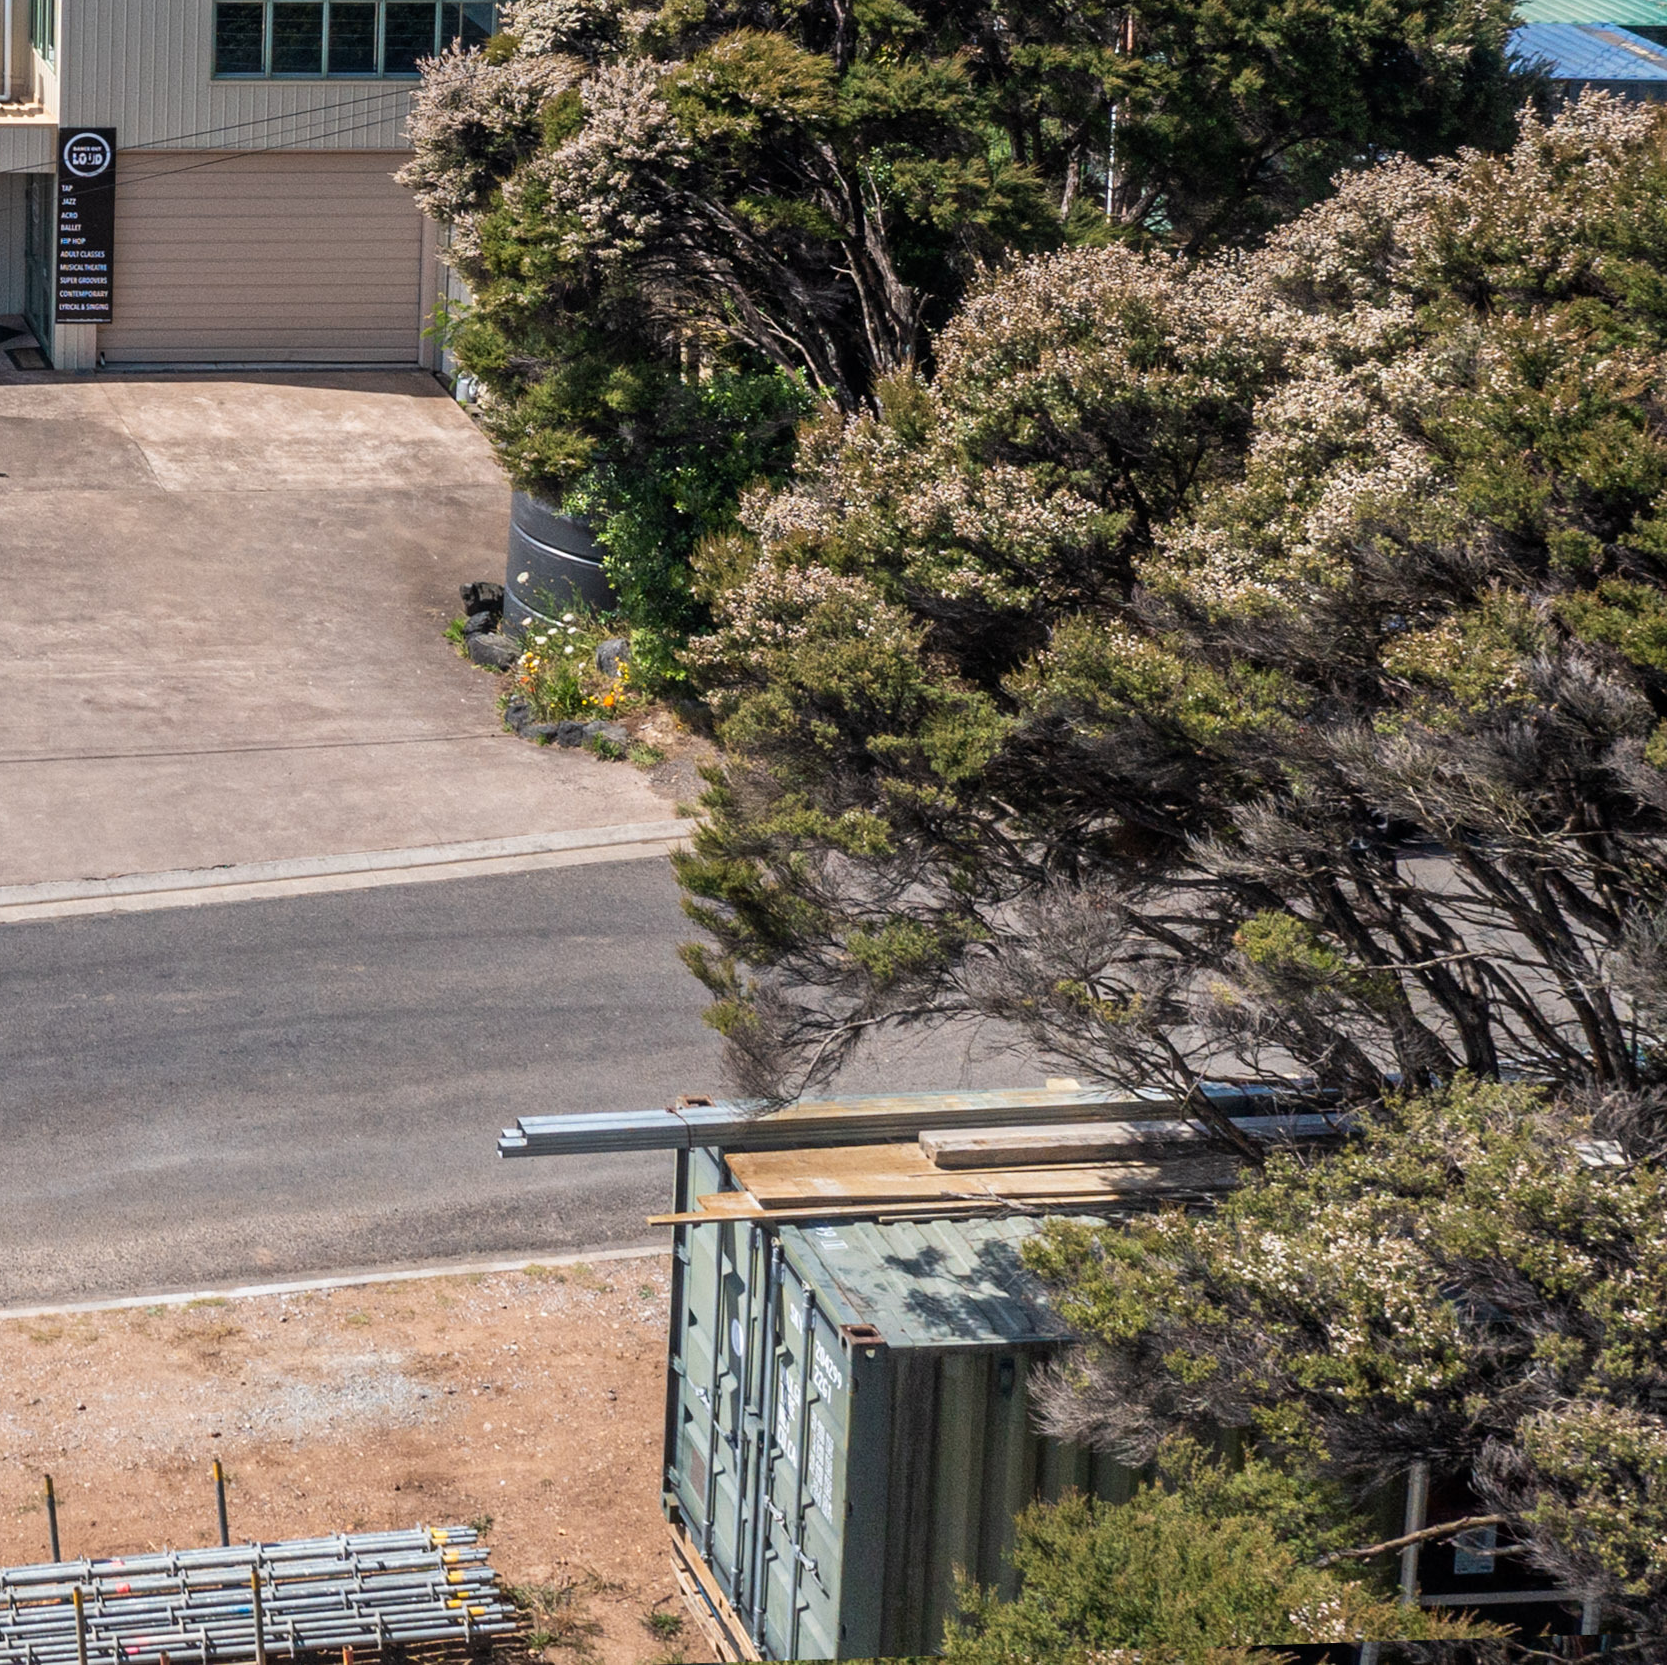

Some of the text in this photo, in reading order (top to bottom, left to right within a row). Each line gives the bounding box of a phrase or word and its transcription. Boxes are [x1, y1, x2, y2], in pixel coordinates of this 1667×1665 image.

[72, 153, 103, 165] LOUD
[61, 184, 73, 192] TAP
[816, 1340, 842, 1390] 204299
